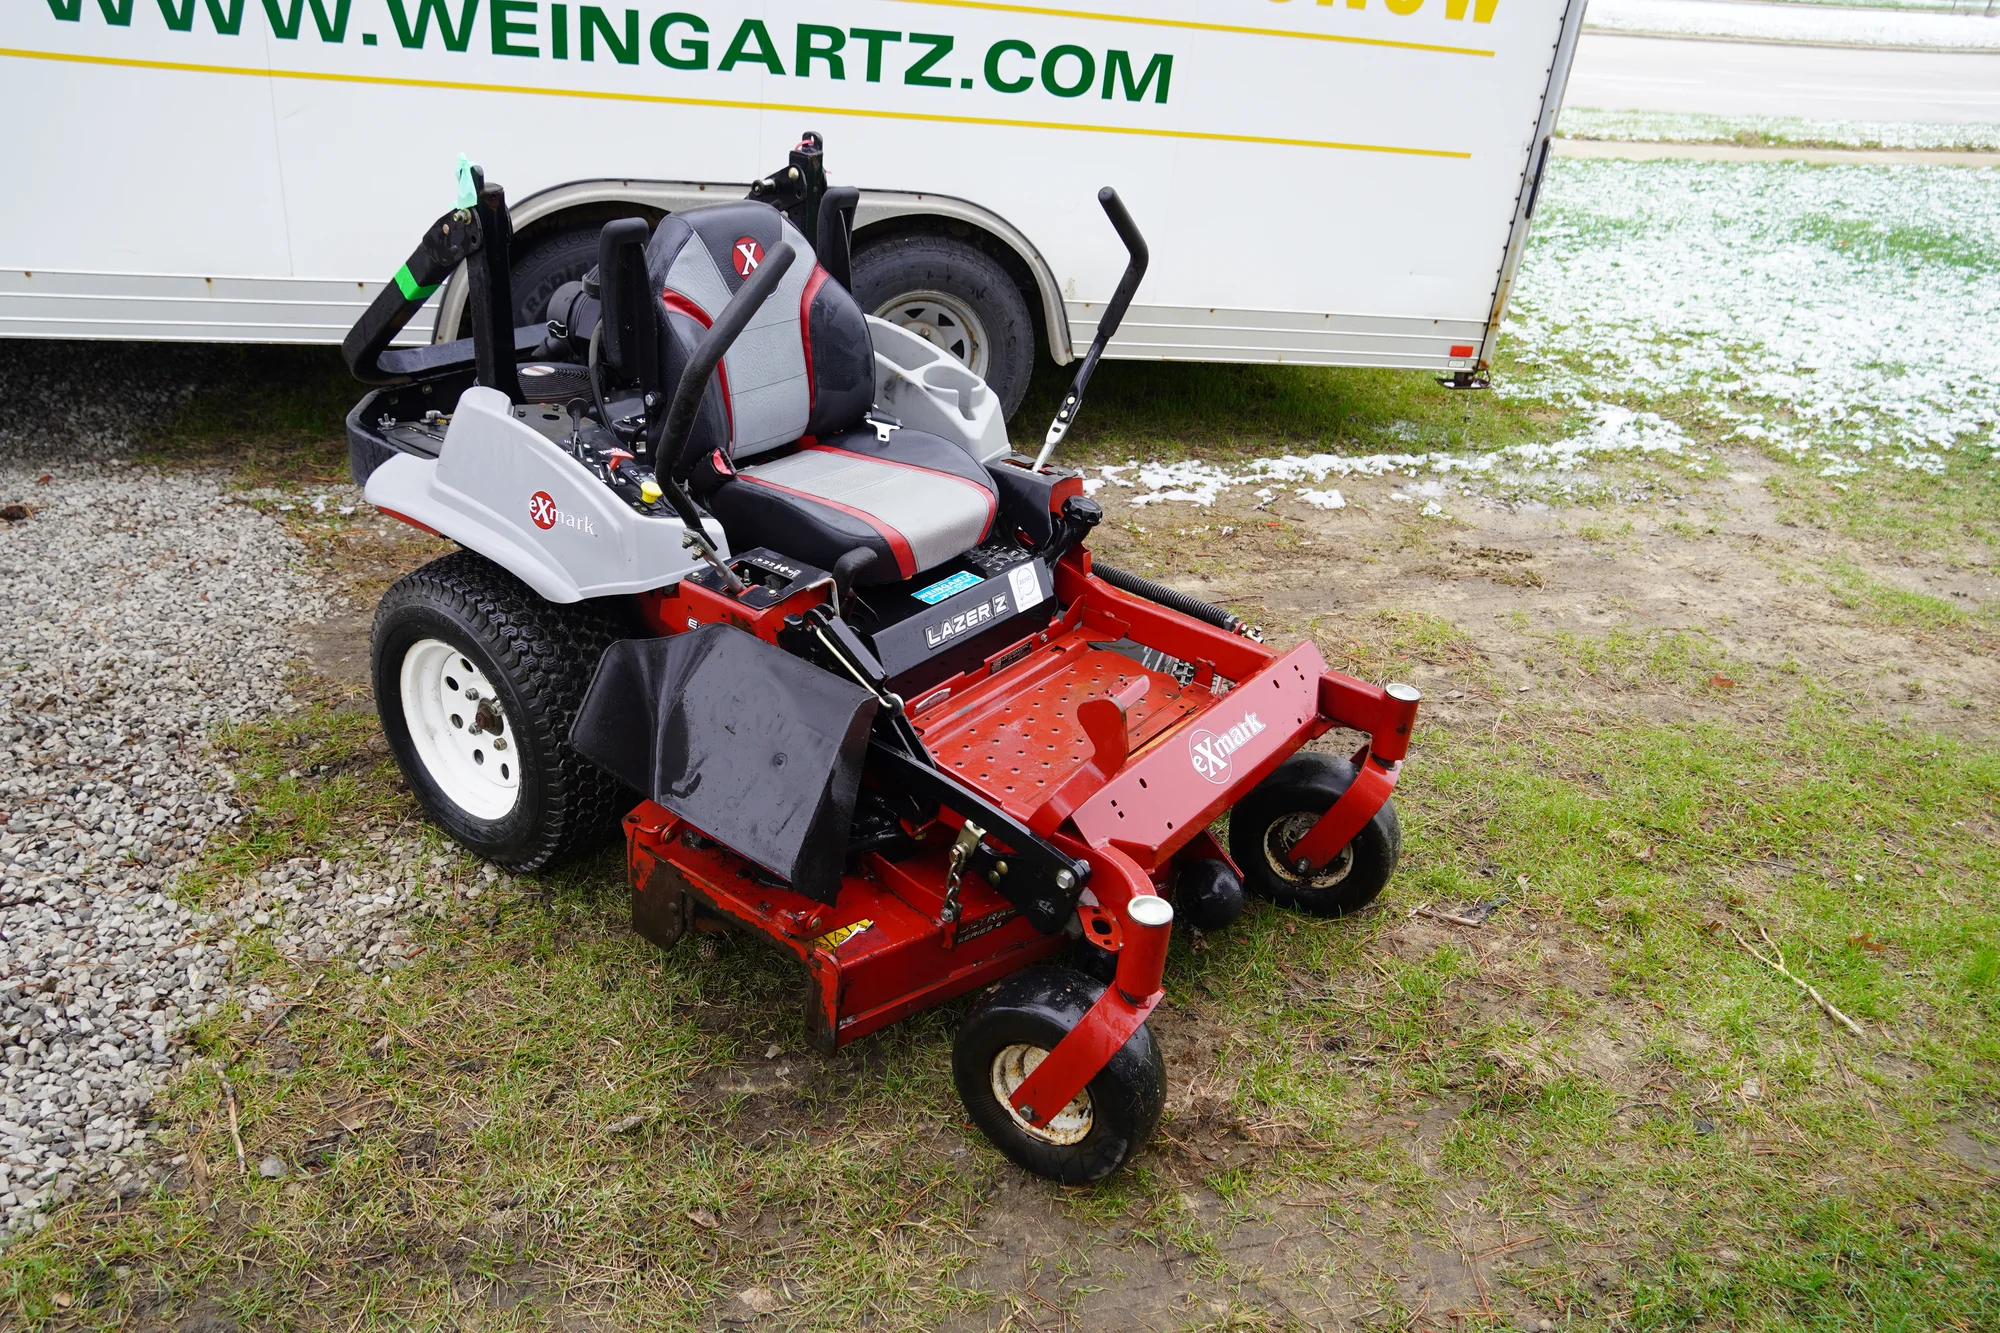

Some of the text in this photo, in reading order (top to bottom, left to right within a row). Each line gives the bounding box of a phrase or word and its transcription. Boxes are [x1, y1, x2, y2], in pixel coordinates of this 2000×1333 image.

[528, 495, 595, 536] eXmark
[925, 593, 1008, 649] LAZER Z
[1192, 710, 1267, 778] eXmark
